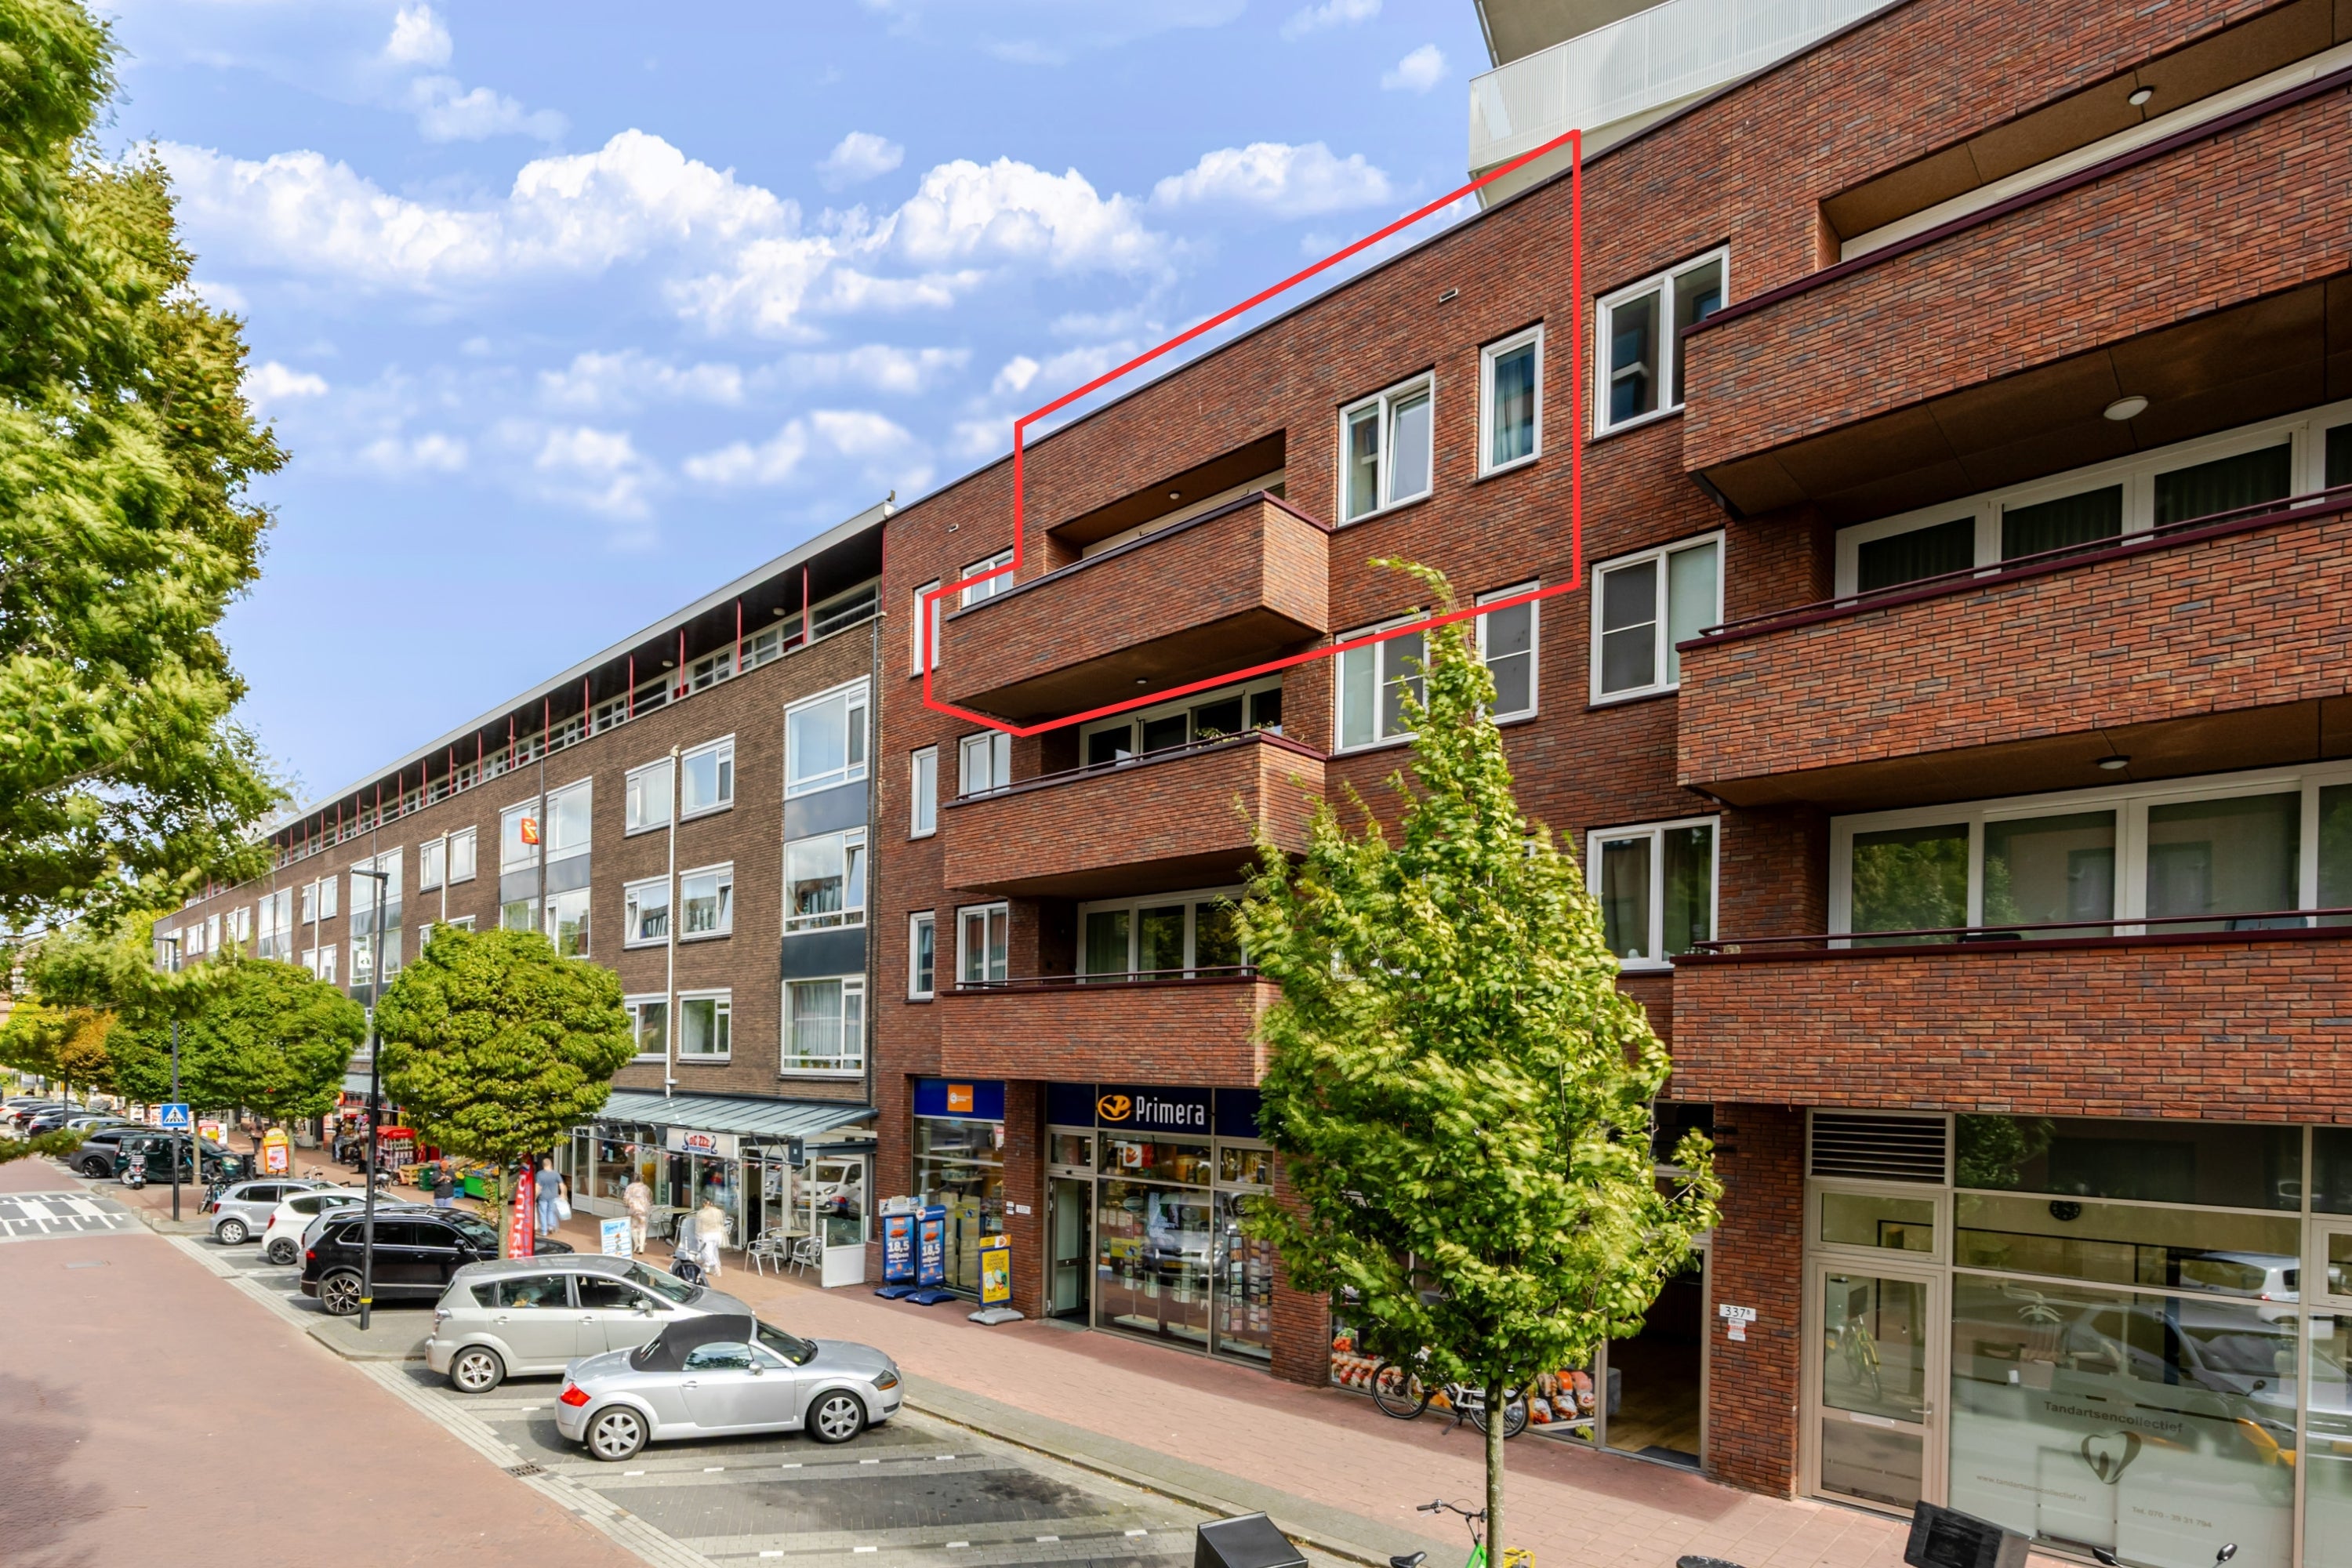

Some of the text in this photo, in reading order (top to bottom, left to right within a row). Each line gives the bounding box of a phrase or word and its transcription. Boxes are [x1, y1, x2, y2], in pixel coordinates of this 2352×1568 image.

[1136, 1095, 1205, 1126] Primera
[887, 1240, 910, 1254] 18,5
[921, 1243, 941, 1257] 18,5
[2043, 1400, 2183, 1432] Tandartsencollectief
[2132, 1505, 2147, 1515] Tel.
[2148, 1509, 2164, 1519] 070
